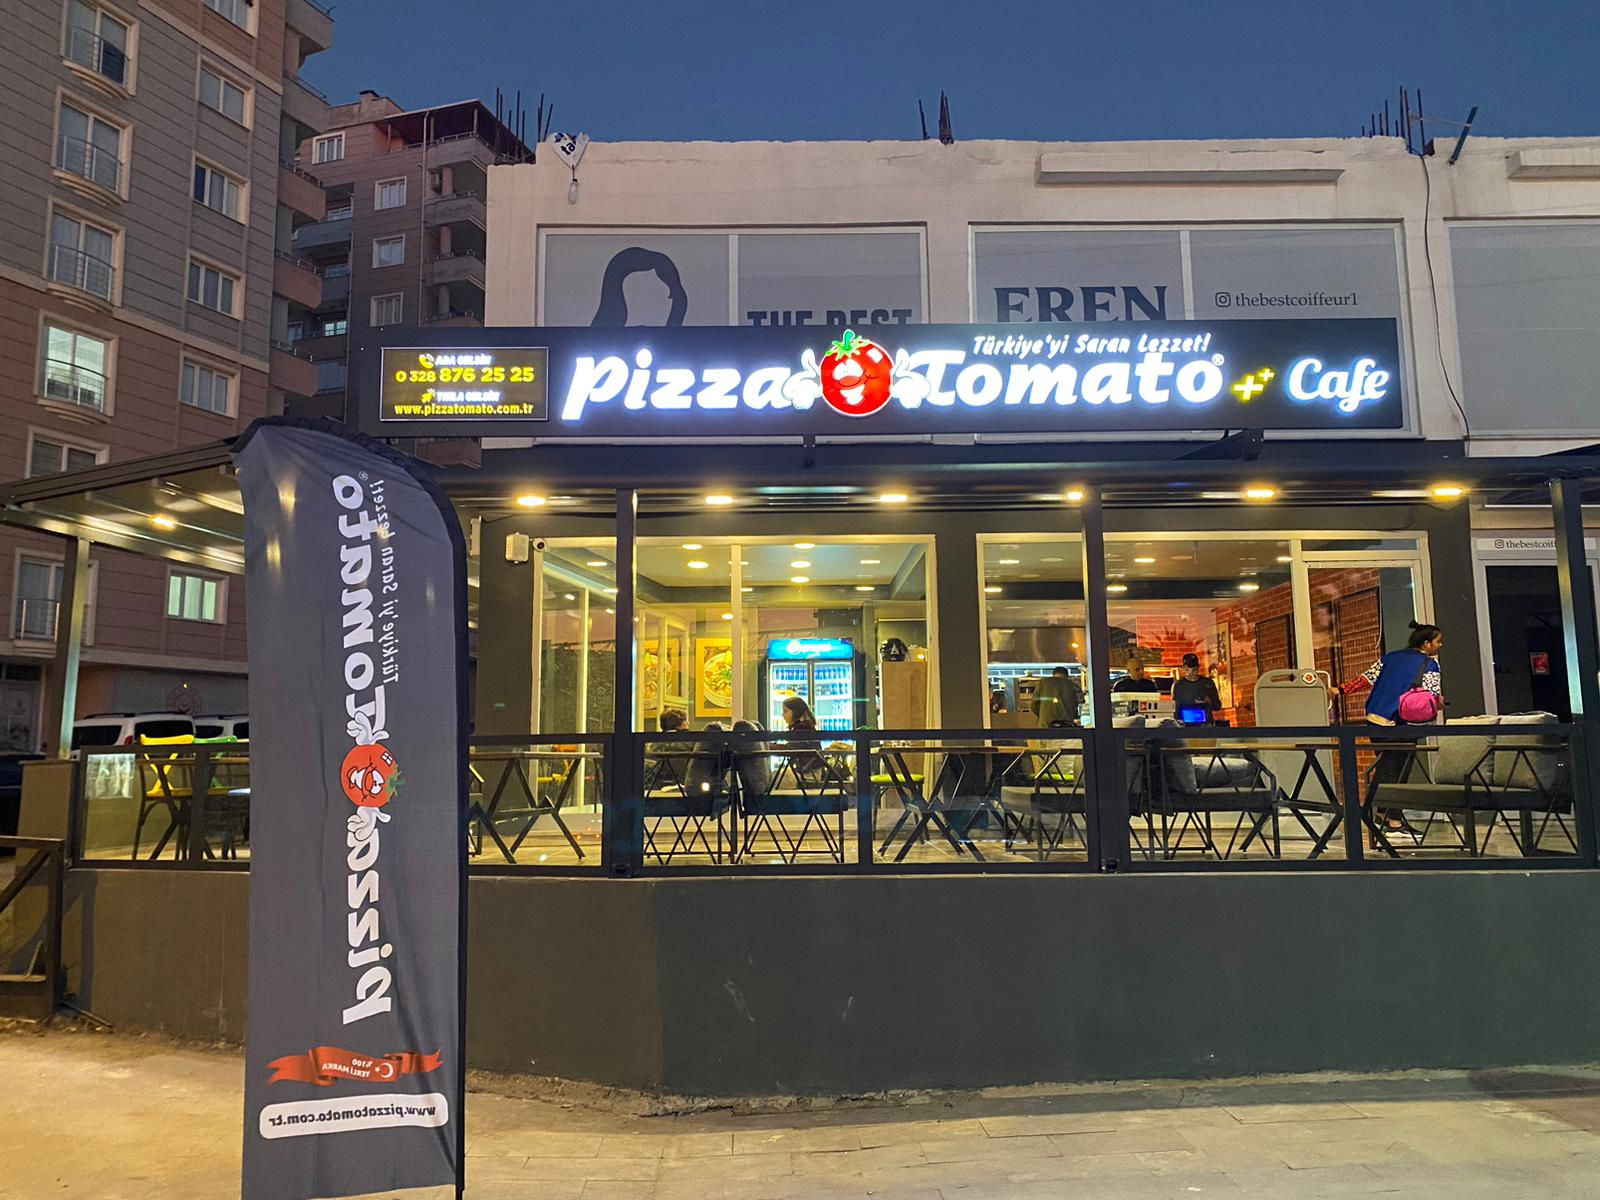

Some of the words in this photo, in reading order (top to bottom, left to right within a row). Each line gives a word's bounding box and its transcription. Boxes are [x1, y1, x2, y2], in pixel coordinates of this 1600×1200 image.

[993, 285, 1168, 322] EREN
[1235, 292, 1358, 307] thebestcoiffeur1
[973, 334, 1070, 360] Türkiye'yi
[1074, 333, 1132, 354] Saran
[1137, 333, 1213, 354] Lezzet!
[409, 370, 437, 383] 328
[439, 367, 477, 383] 876
[481, 366, 506, 383] 25
[509, 366, 536, 383] 25
[1289, 358, 1390, 413] Cafe
[394, 402, 535, 417] www.pizzatomato.com.tr
